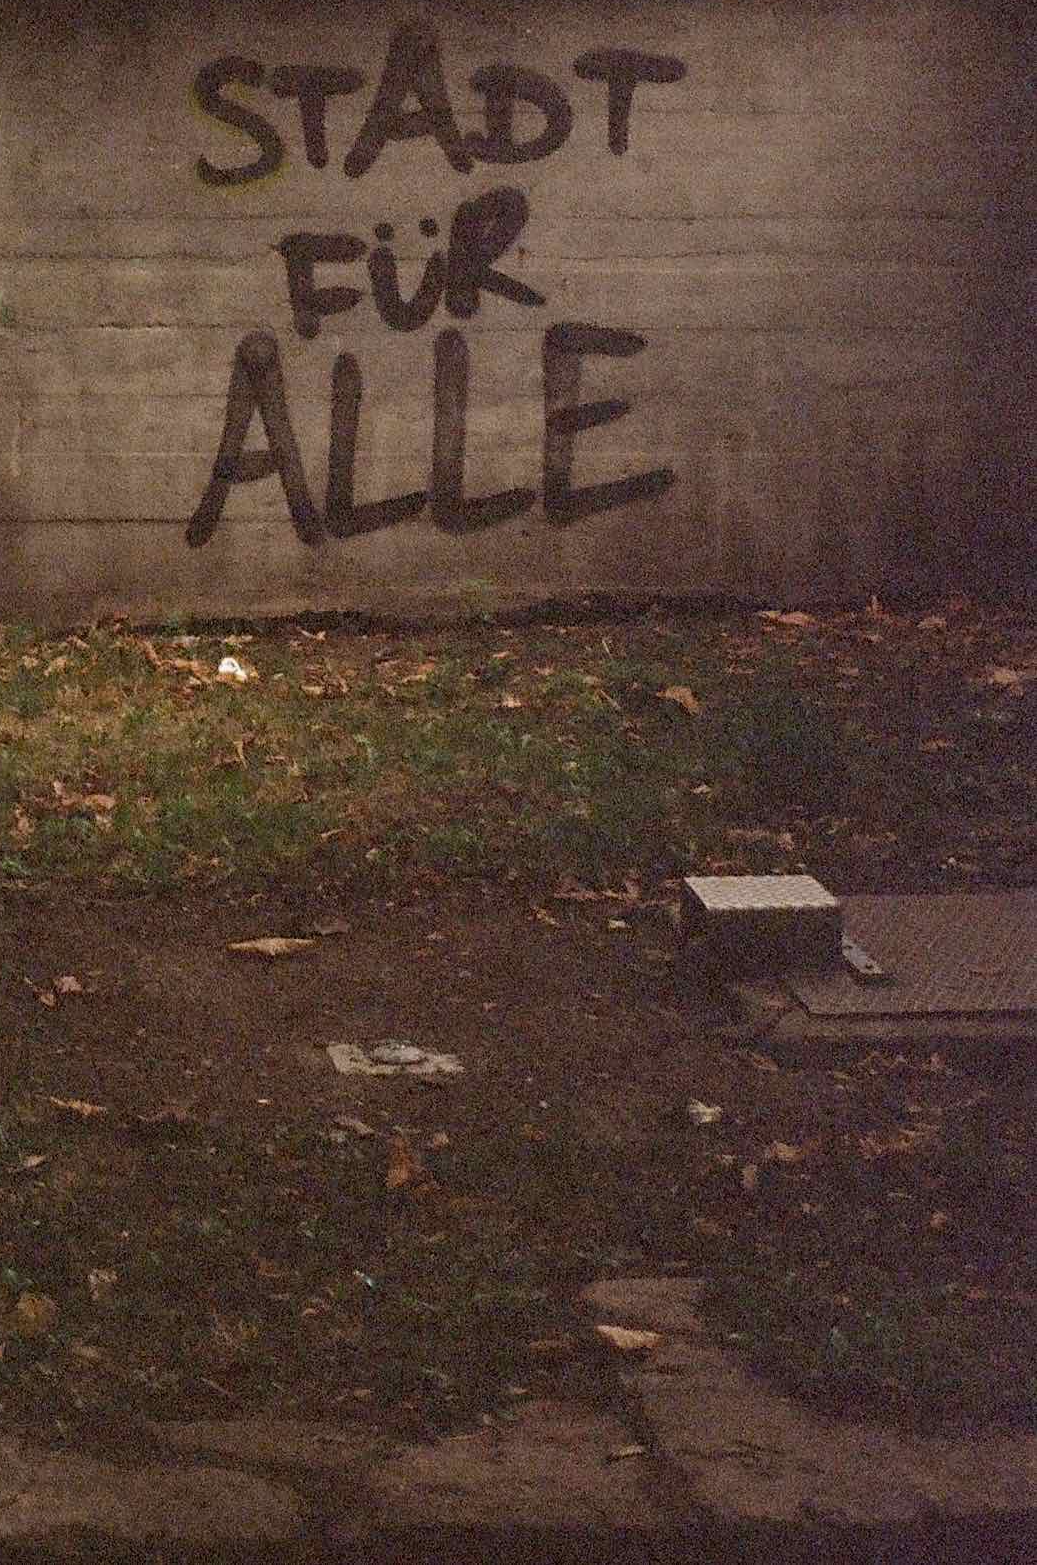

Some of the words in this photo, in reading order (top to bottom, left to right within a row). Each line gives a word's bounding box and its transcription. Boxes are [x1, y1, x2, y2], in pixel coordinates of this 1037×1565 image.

[194, 19, 686, 186] STADT
[275, 187, 546, 339] FÜR
[184, 323, 675, 547] ALLE
